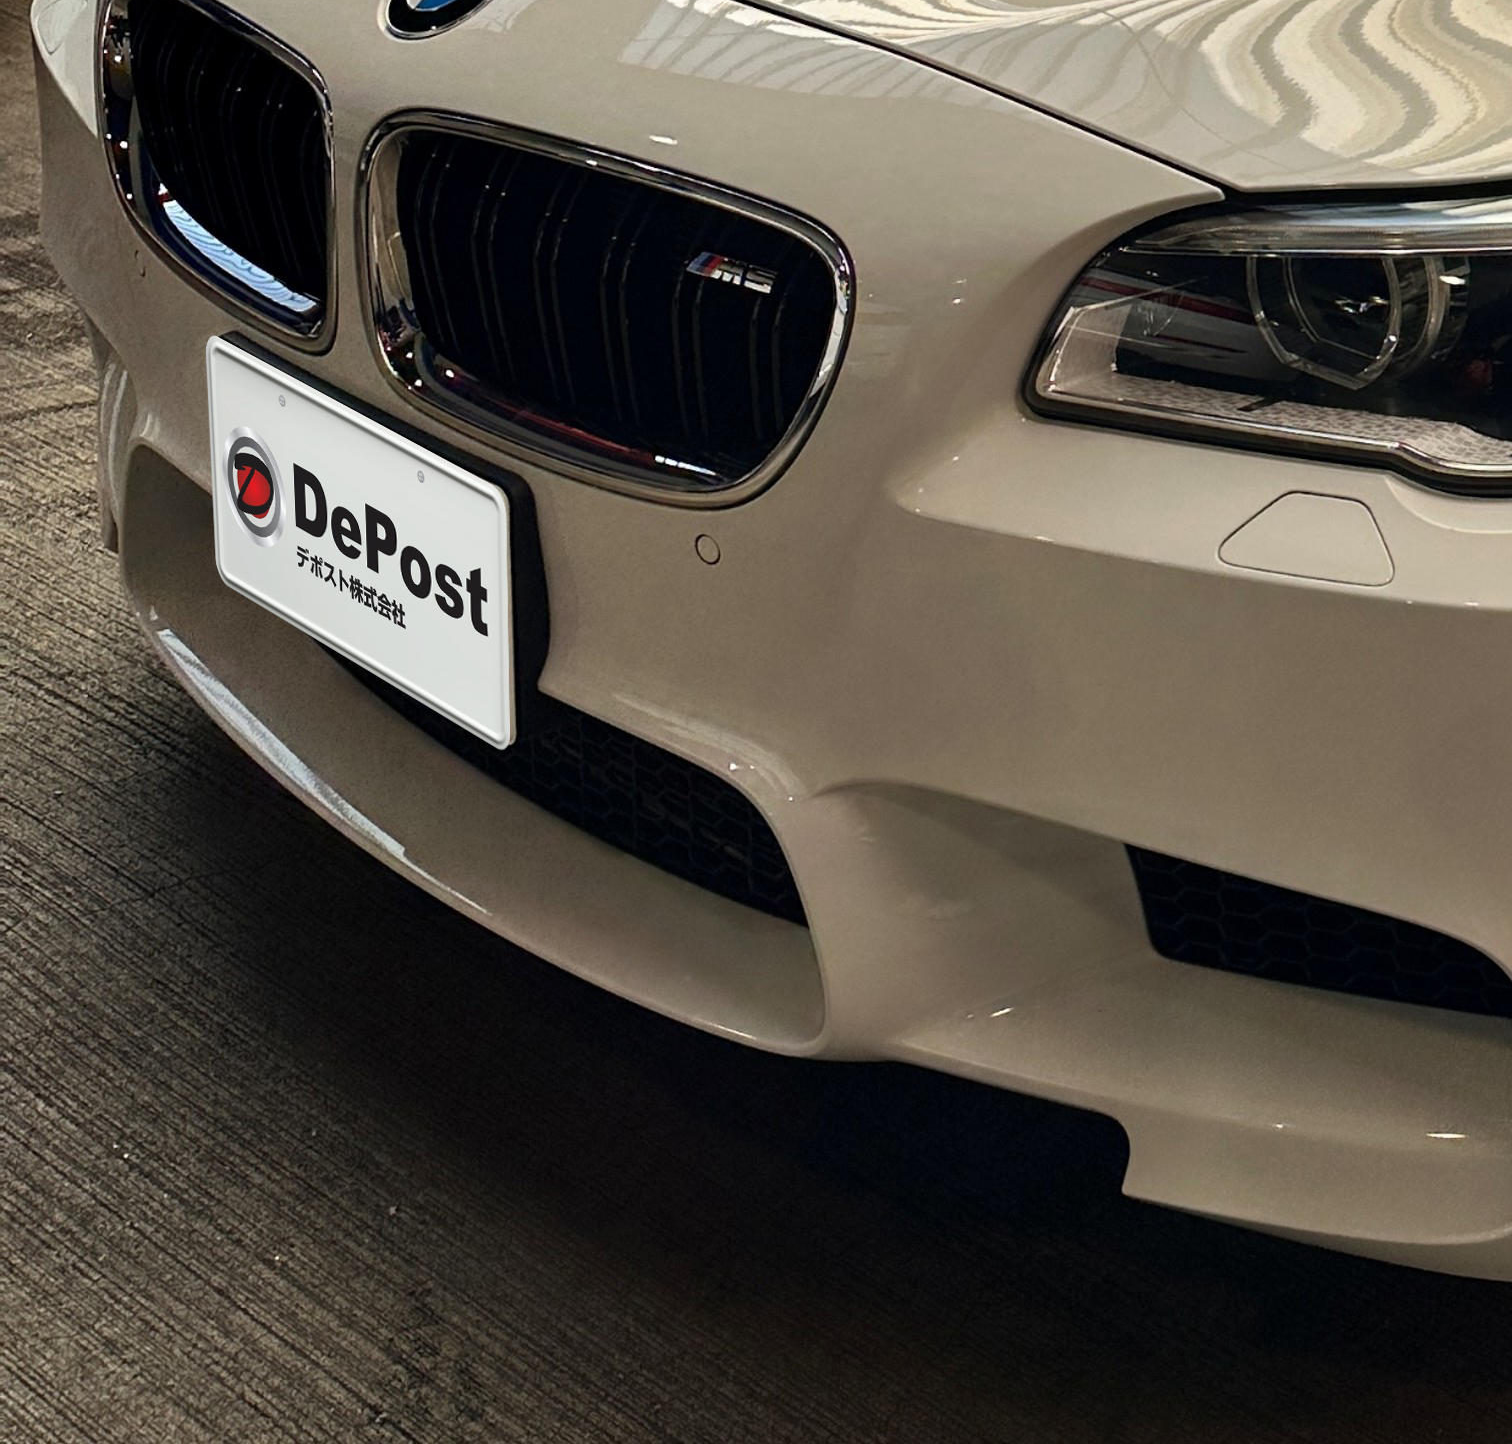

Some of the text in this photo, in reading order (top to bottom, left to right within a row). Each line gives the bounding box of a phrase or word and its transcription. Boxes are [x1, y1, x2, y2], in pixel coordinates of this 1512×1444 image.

[292, 462, 489, 637] DePost
[296, 545, 406, 630] デポスト株式会社
